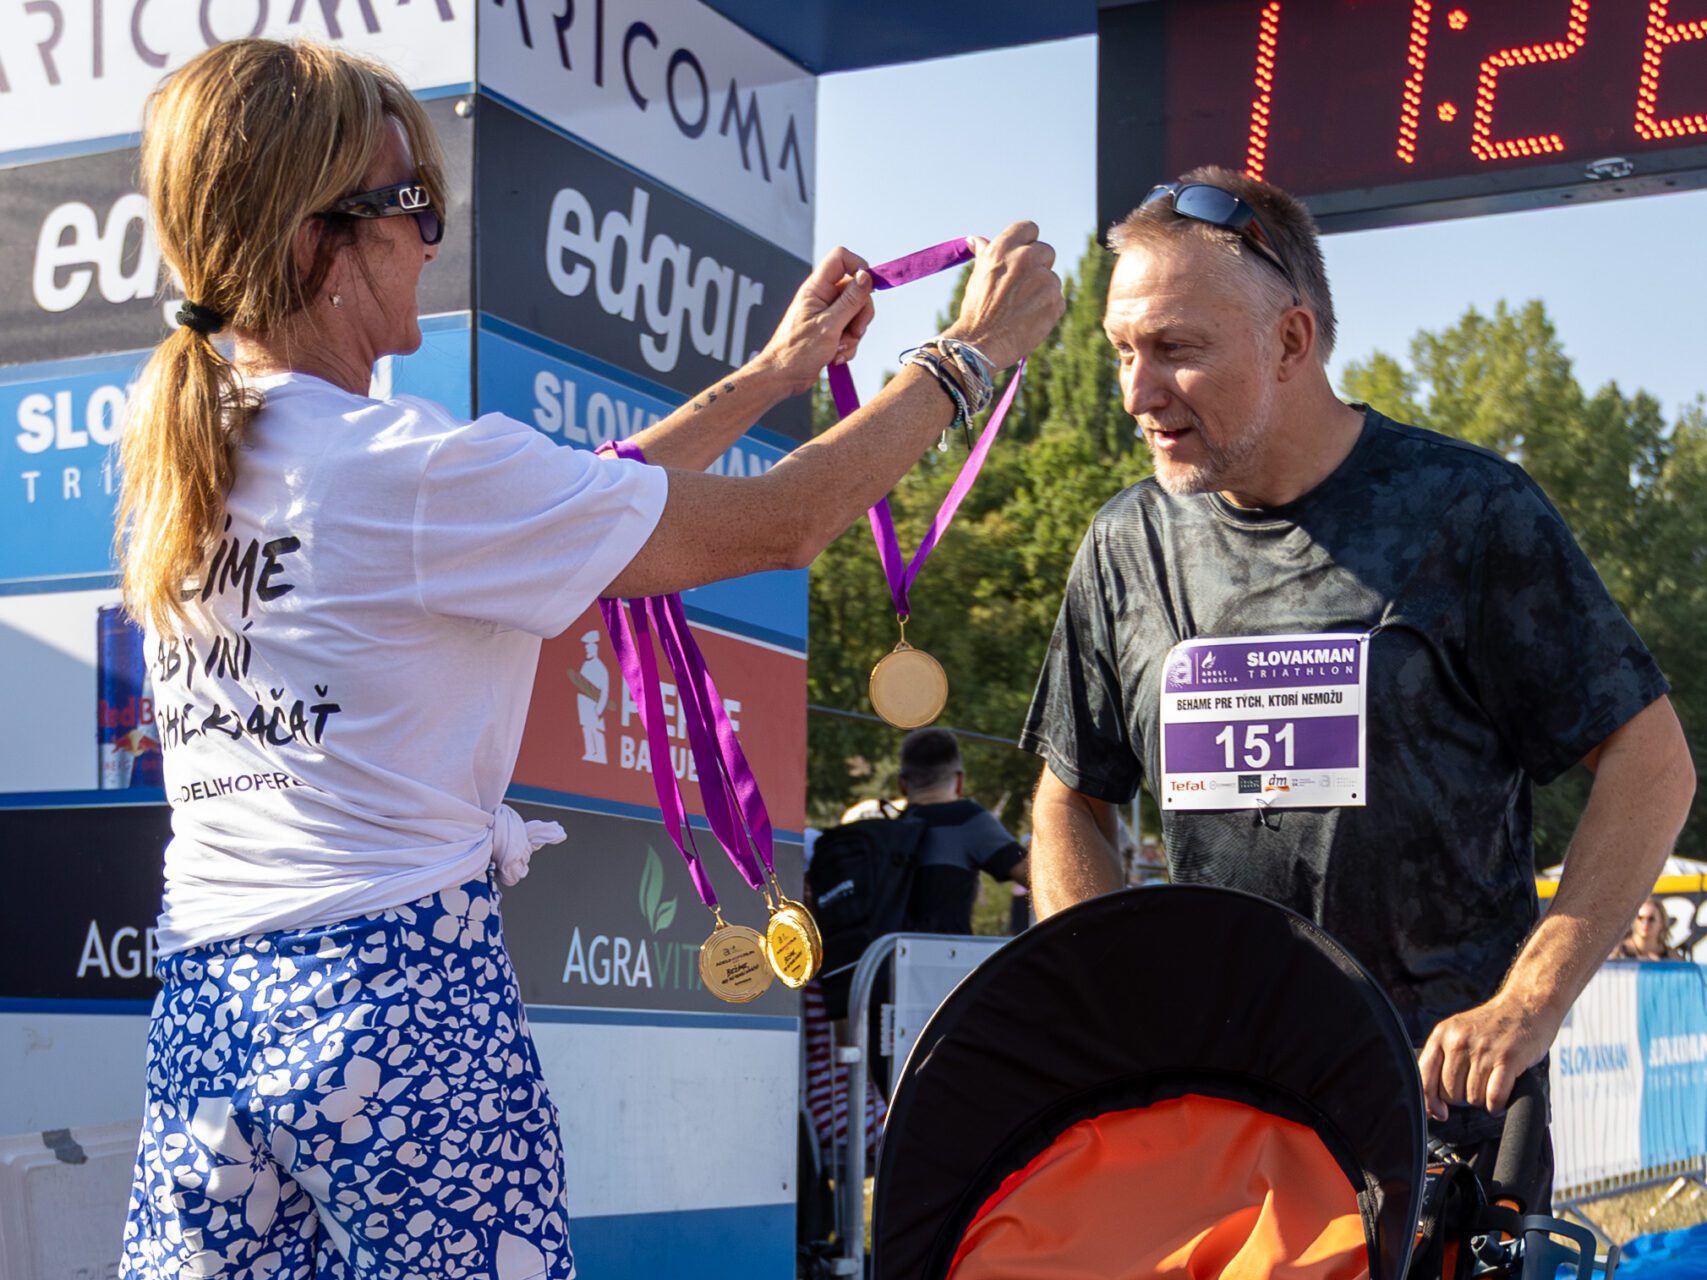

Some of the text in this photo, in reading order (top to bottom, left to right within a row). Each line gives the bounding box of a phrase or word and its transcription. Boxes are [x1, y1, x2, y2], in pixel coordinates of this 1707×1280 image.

[546, 187, 764, 373] edgar
[16, 384, 127, 455] SLO
[20, 464, 113, 503] TRI
[183, 514, 301, 618] ÍME
[1247, 648, 1355, 667] SLOVAKMAN
[1247, 666, 1354, 679] TRIATHLON
[1215, 696, 1232, 709] PRE
[1215, 722, 1295, 768] 151
[173, 772, 306, 803] DELIHOPER
[1170, 780, 1207, 792] Tefal
[1268, 774, 1287, 786] dm
[562, 926, 703, 992] AGRAVIT
